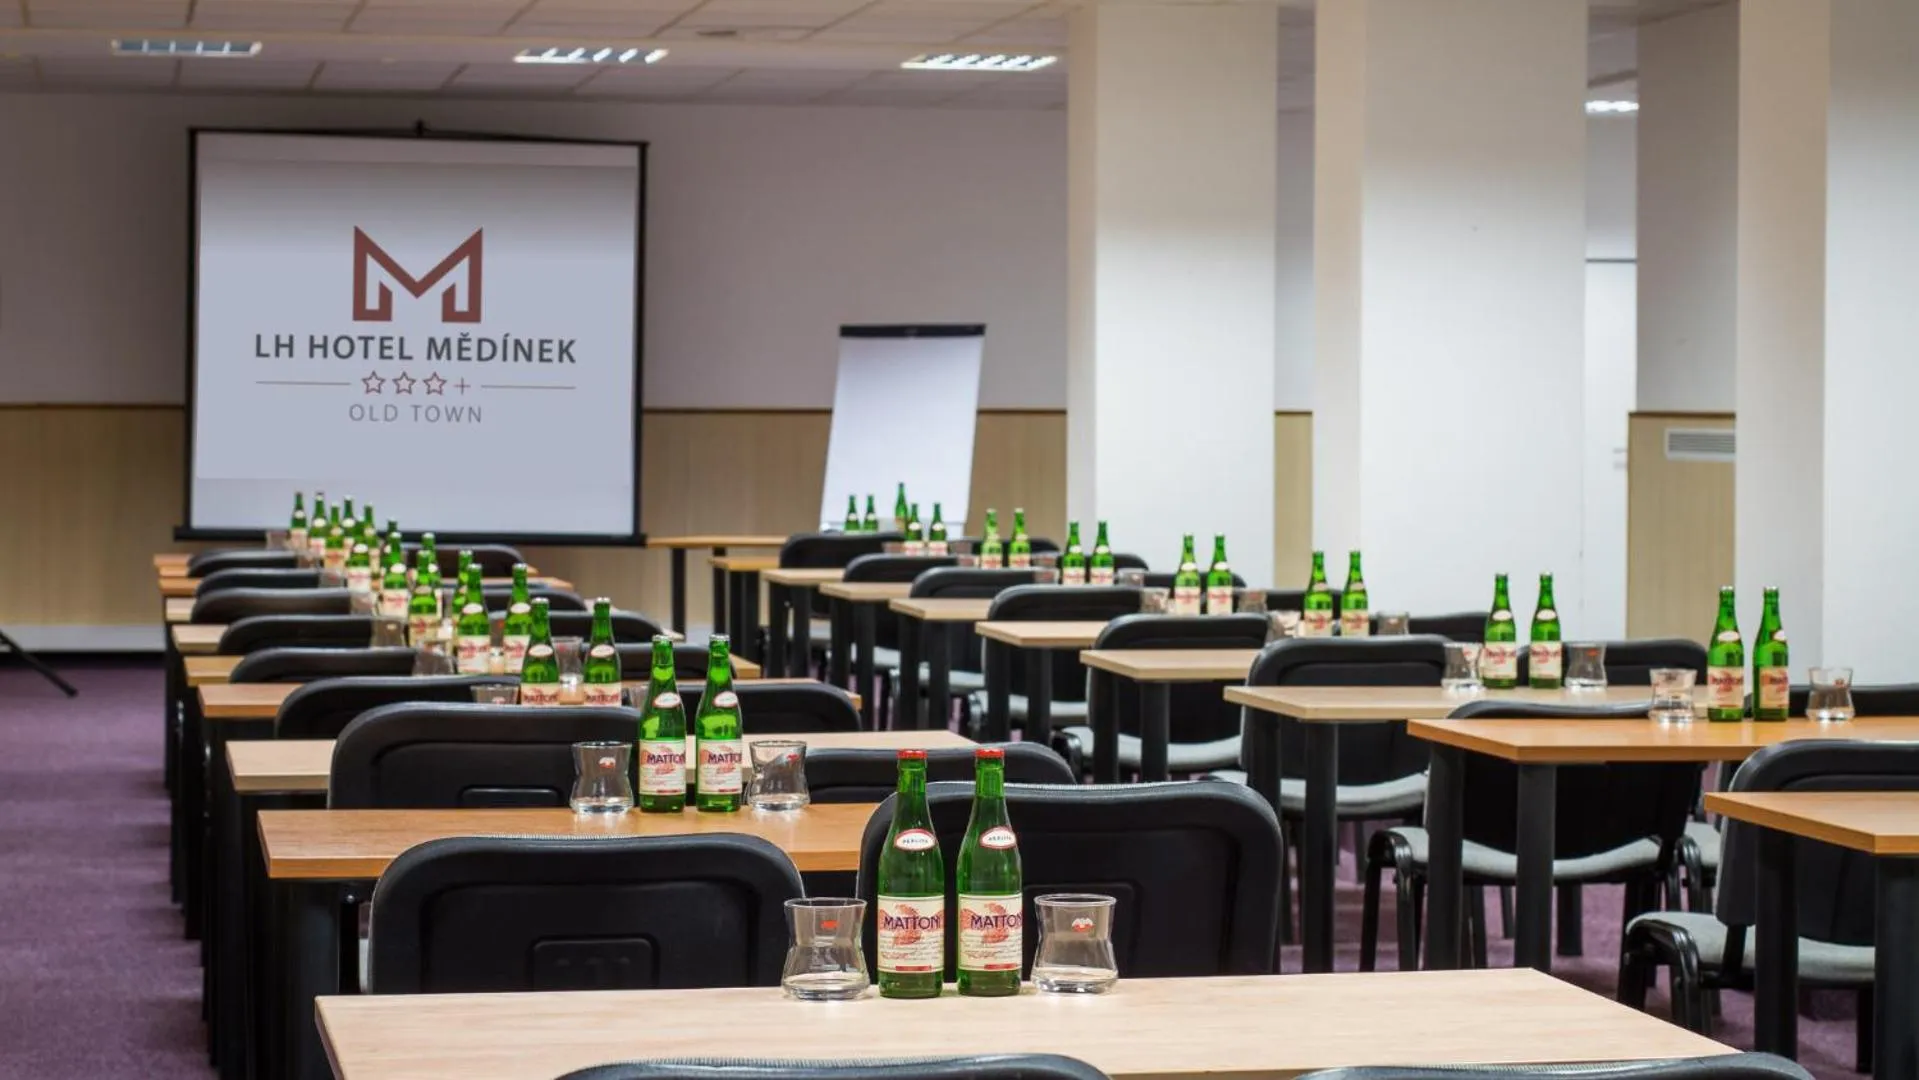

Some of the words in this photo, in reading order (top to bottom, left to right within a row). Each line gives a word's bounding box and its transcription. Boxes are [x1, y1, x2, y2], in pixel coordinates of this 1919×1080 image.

[255, 334, 294, 358] LH
[308, 335, 413, 361] HOTEL
[426, 333, 576, 363] MĚDÍNEK
[349, 404, 398, 422] OLD
[411, 405, 482, 423] TOWN
